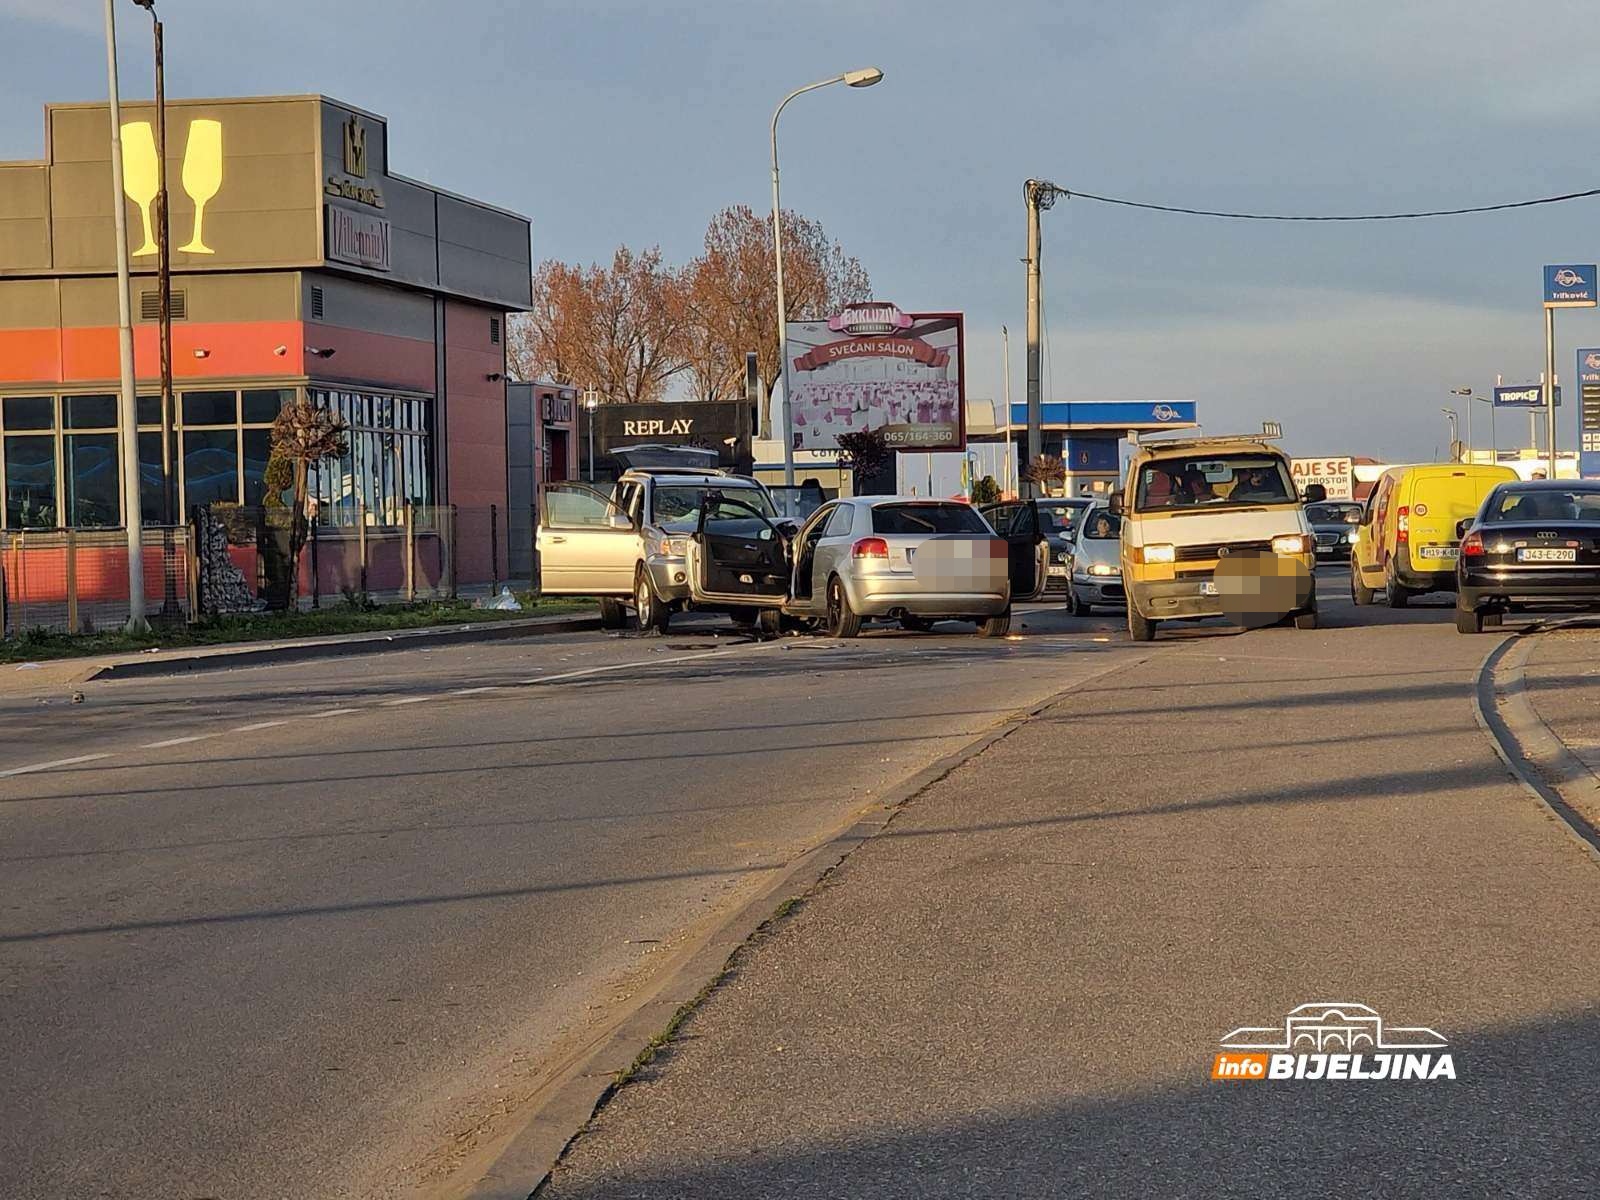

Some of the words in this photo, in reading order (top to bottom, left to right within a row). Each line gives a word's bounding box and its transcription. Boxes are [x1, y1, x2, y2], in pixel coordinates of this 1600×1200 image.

[829, 343, 875, 357] SVEČANI
[879, 342, 914, 355] SALON
[624, 419, 693, 436] REPLAY
[1326, 461, 1347, 475] SE
